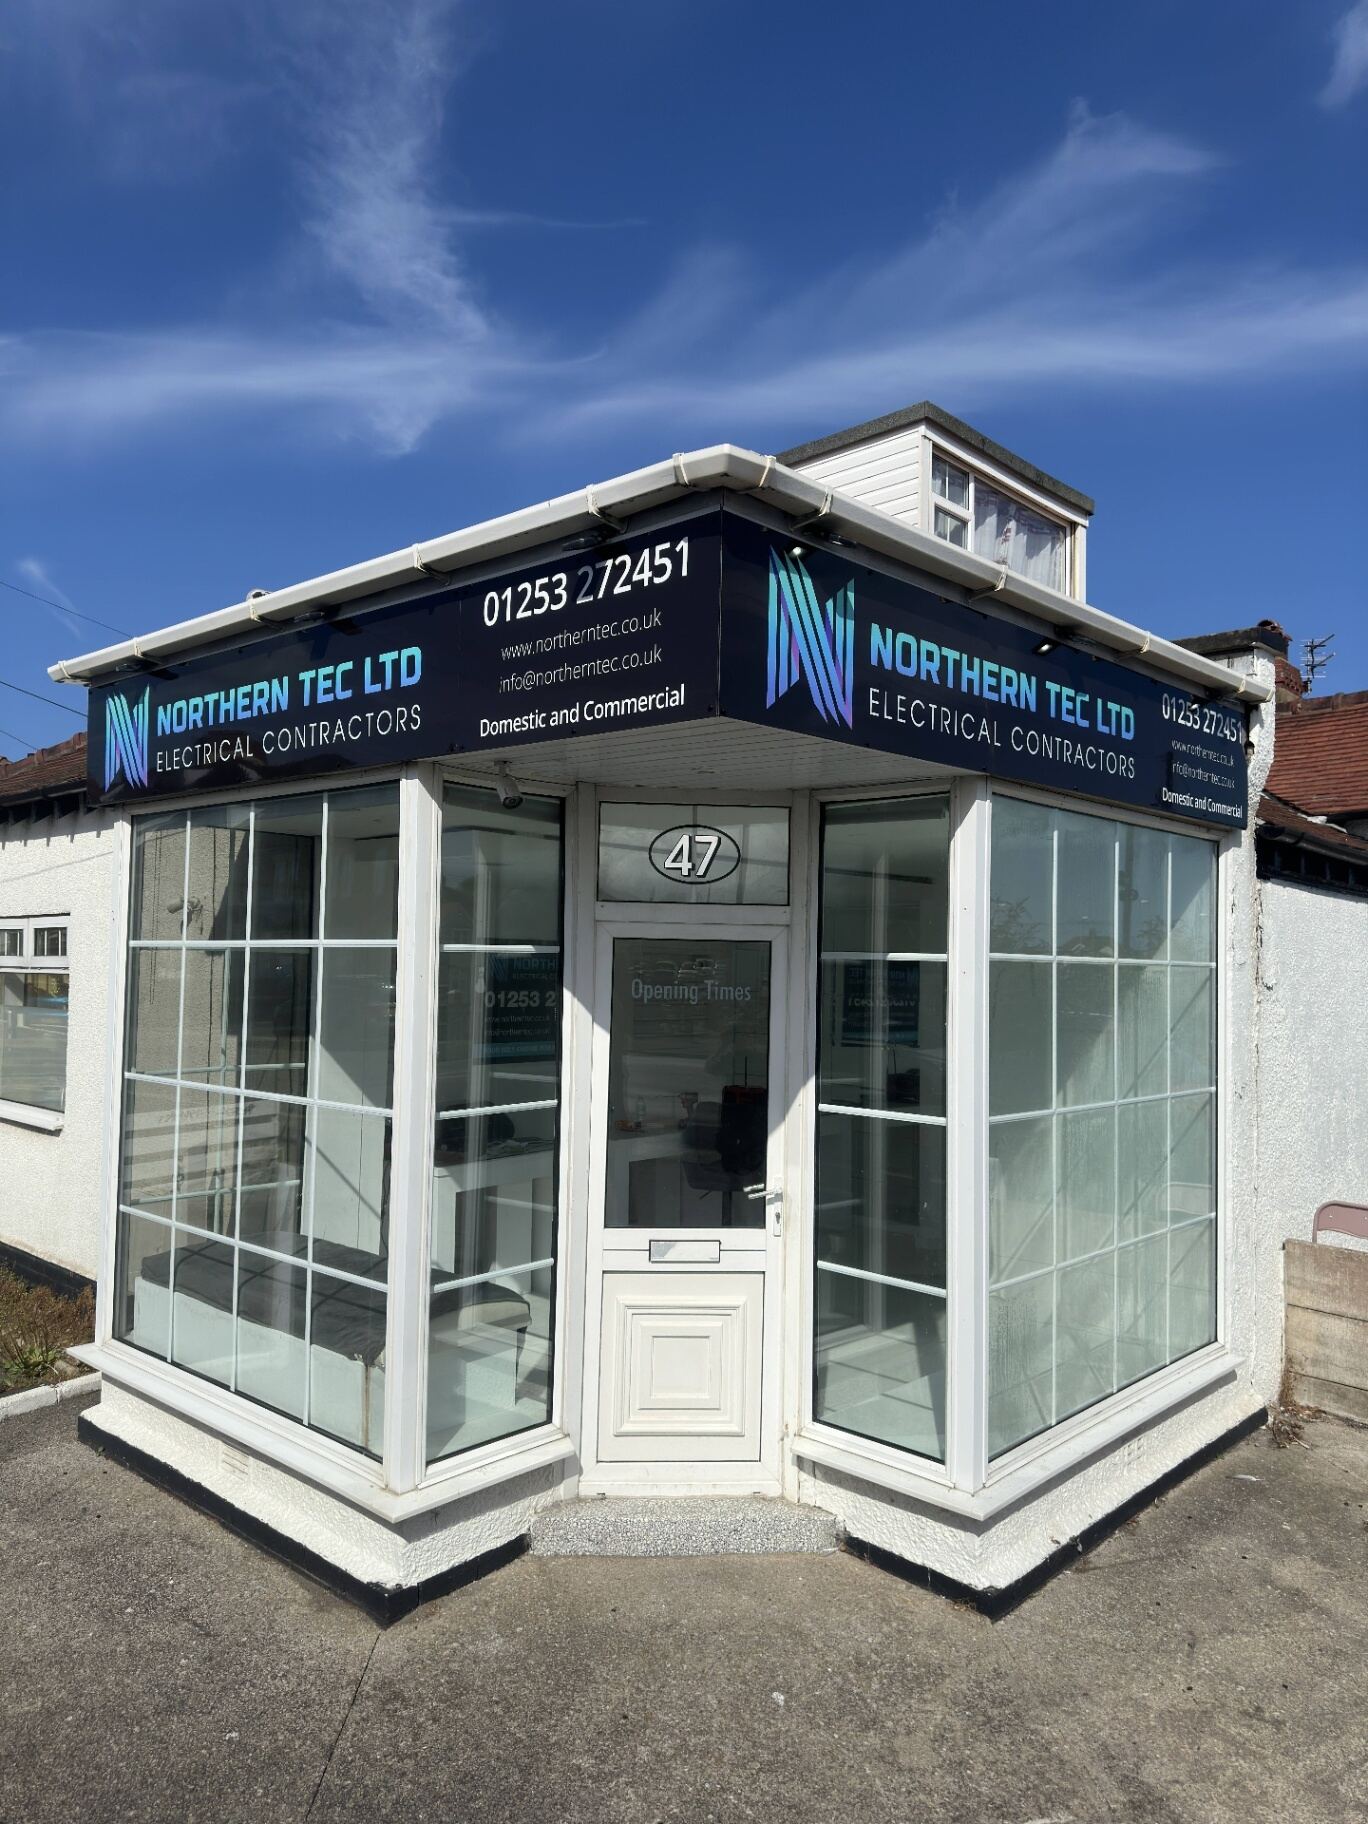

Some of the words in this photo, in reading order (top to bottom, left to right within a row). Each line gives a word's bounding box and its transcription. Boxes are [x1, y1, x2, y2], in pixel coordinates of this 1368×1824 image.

[483, 572, 567, 626] 01253
[576, 537, 689, 604] 272451
[500, 607, 662, 661] www.northerntec.co.uk
[157, 676, 289, 736] NORTHERN
[299, 661, 353, 707] TEC
[364, 646, 422, 695] LTD
[499, 643, 662, 693] info@northerntec.co.uk
[870, 622, 1036, 713] NORTHERN
[1045, 681, 1090, 728] TEC
[1096, 698, 1135, 741] LTD
[480, 709, 546, 737] Domestic
[550, 702, 579, 726] and
[583, 683, 685, 720] Commercial
[869, 687, 1001, 747] ELECTRICAL
[1011, 726, 1135, 778] CONTRACTORS
[1162, 693, 1200, 729] 01253
[1202, 708, 1242, 744] 272451
[157, 735, 253, 772] ELECTRICAL
[262, 704, 421, 754] CONTRACTORS
[1162, 787, 1194, 808] Domestic
[1195, 797, 1207, 810] and
[1207, 798, 1243, 819] Commercial
[664, 834, 722, 878] 47
[485, 991, 540, 1007] 01253
[631, 978, 698, 1005] Opening
[704, 979, 751, 1001] Times
